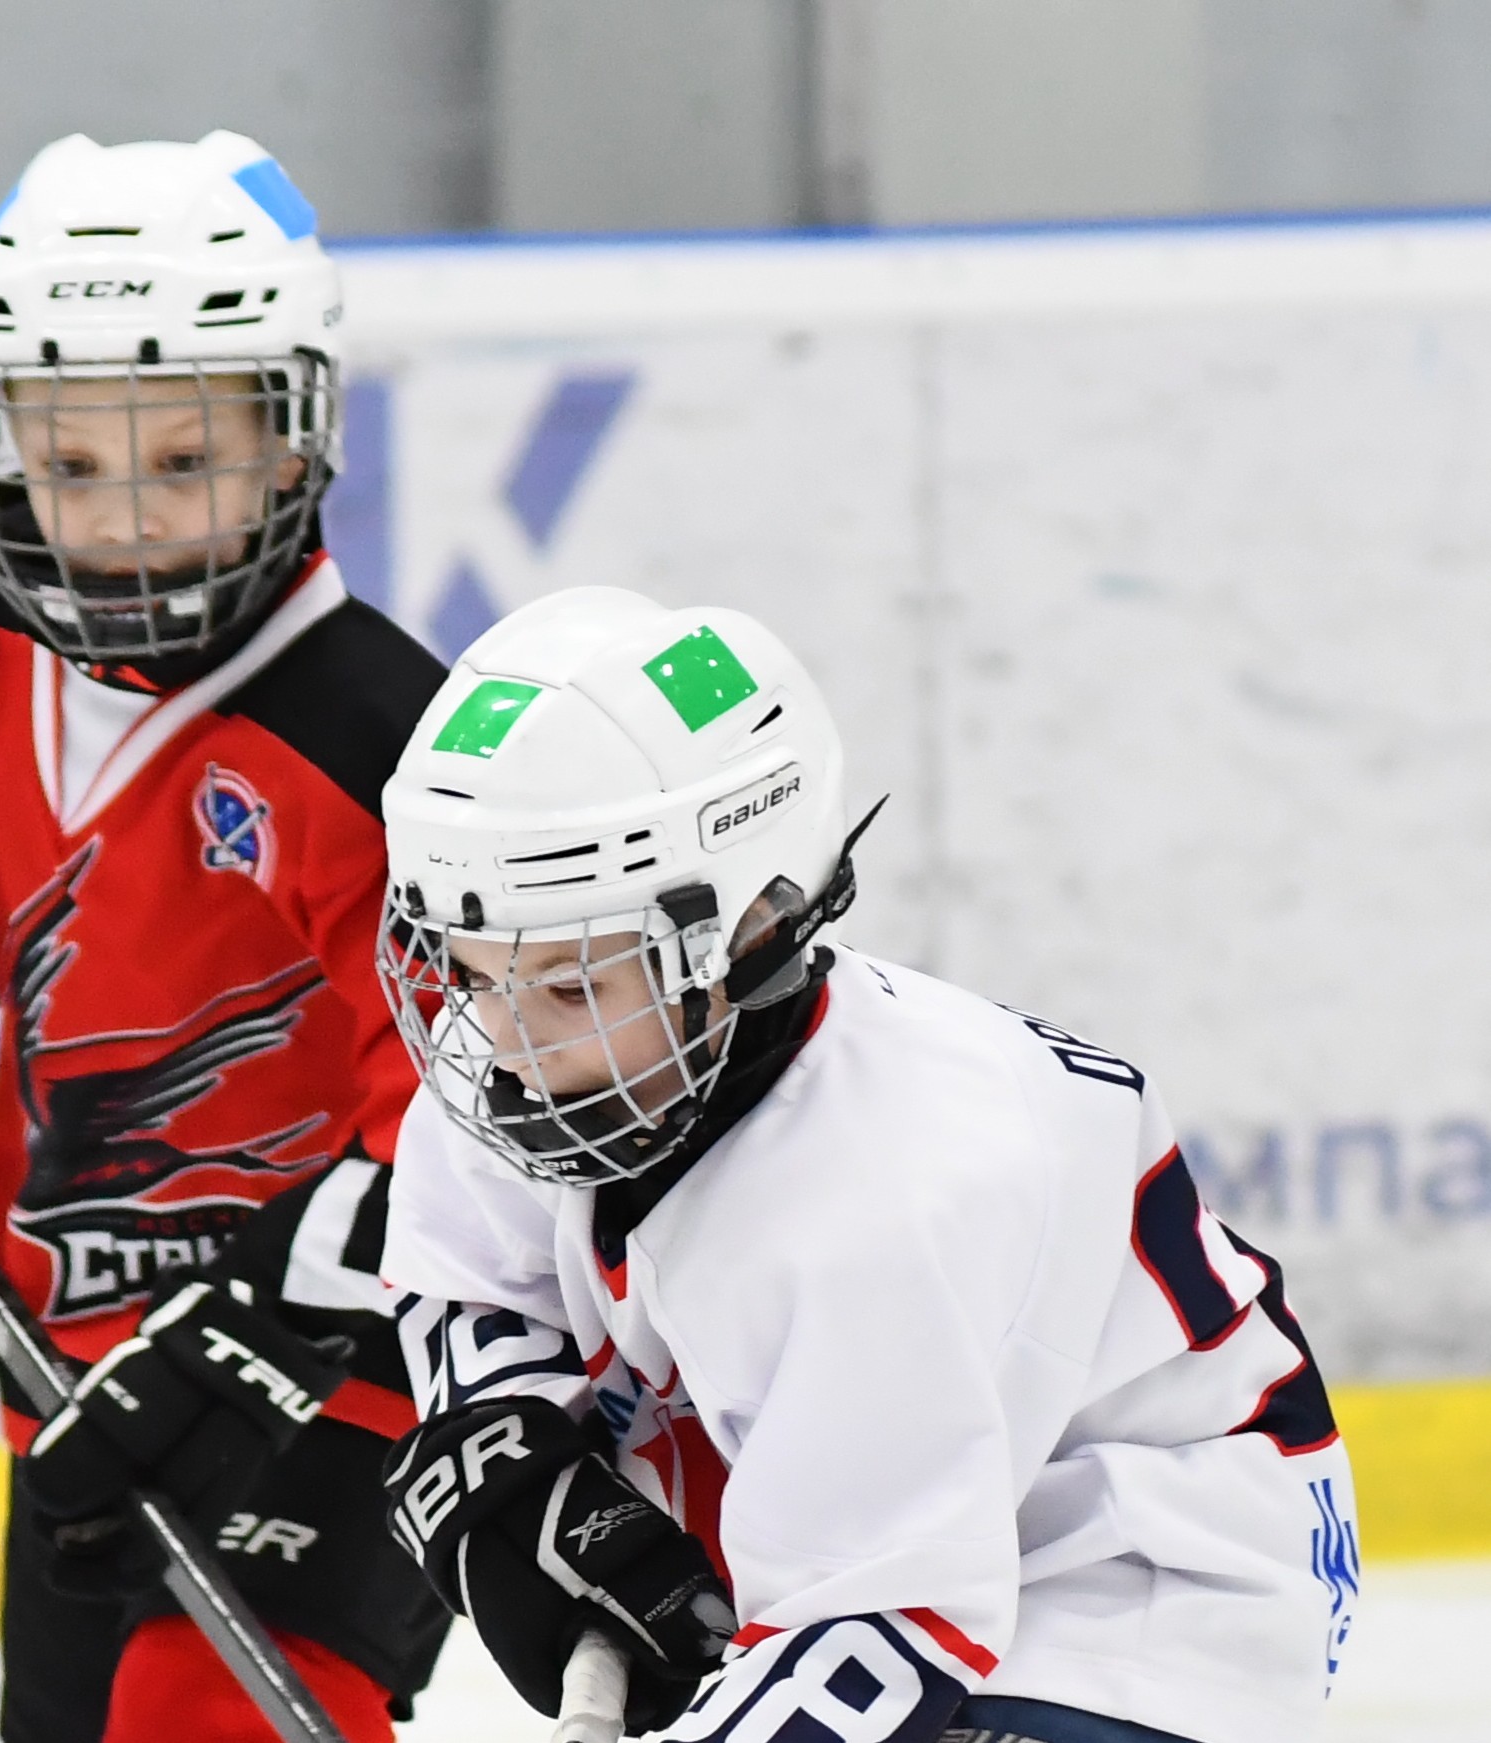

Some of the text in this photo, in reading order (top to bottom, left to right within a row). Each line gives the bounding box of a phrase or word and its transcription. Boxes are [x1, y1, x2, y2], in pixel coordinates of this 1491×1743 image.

[48, 280, 155, 299] CCM
[712, 775, 802, 837] BAUER
[201, 1326, 322, 1424] TRU
